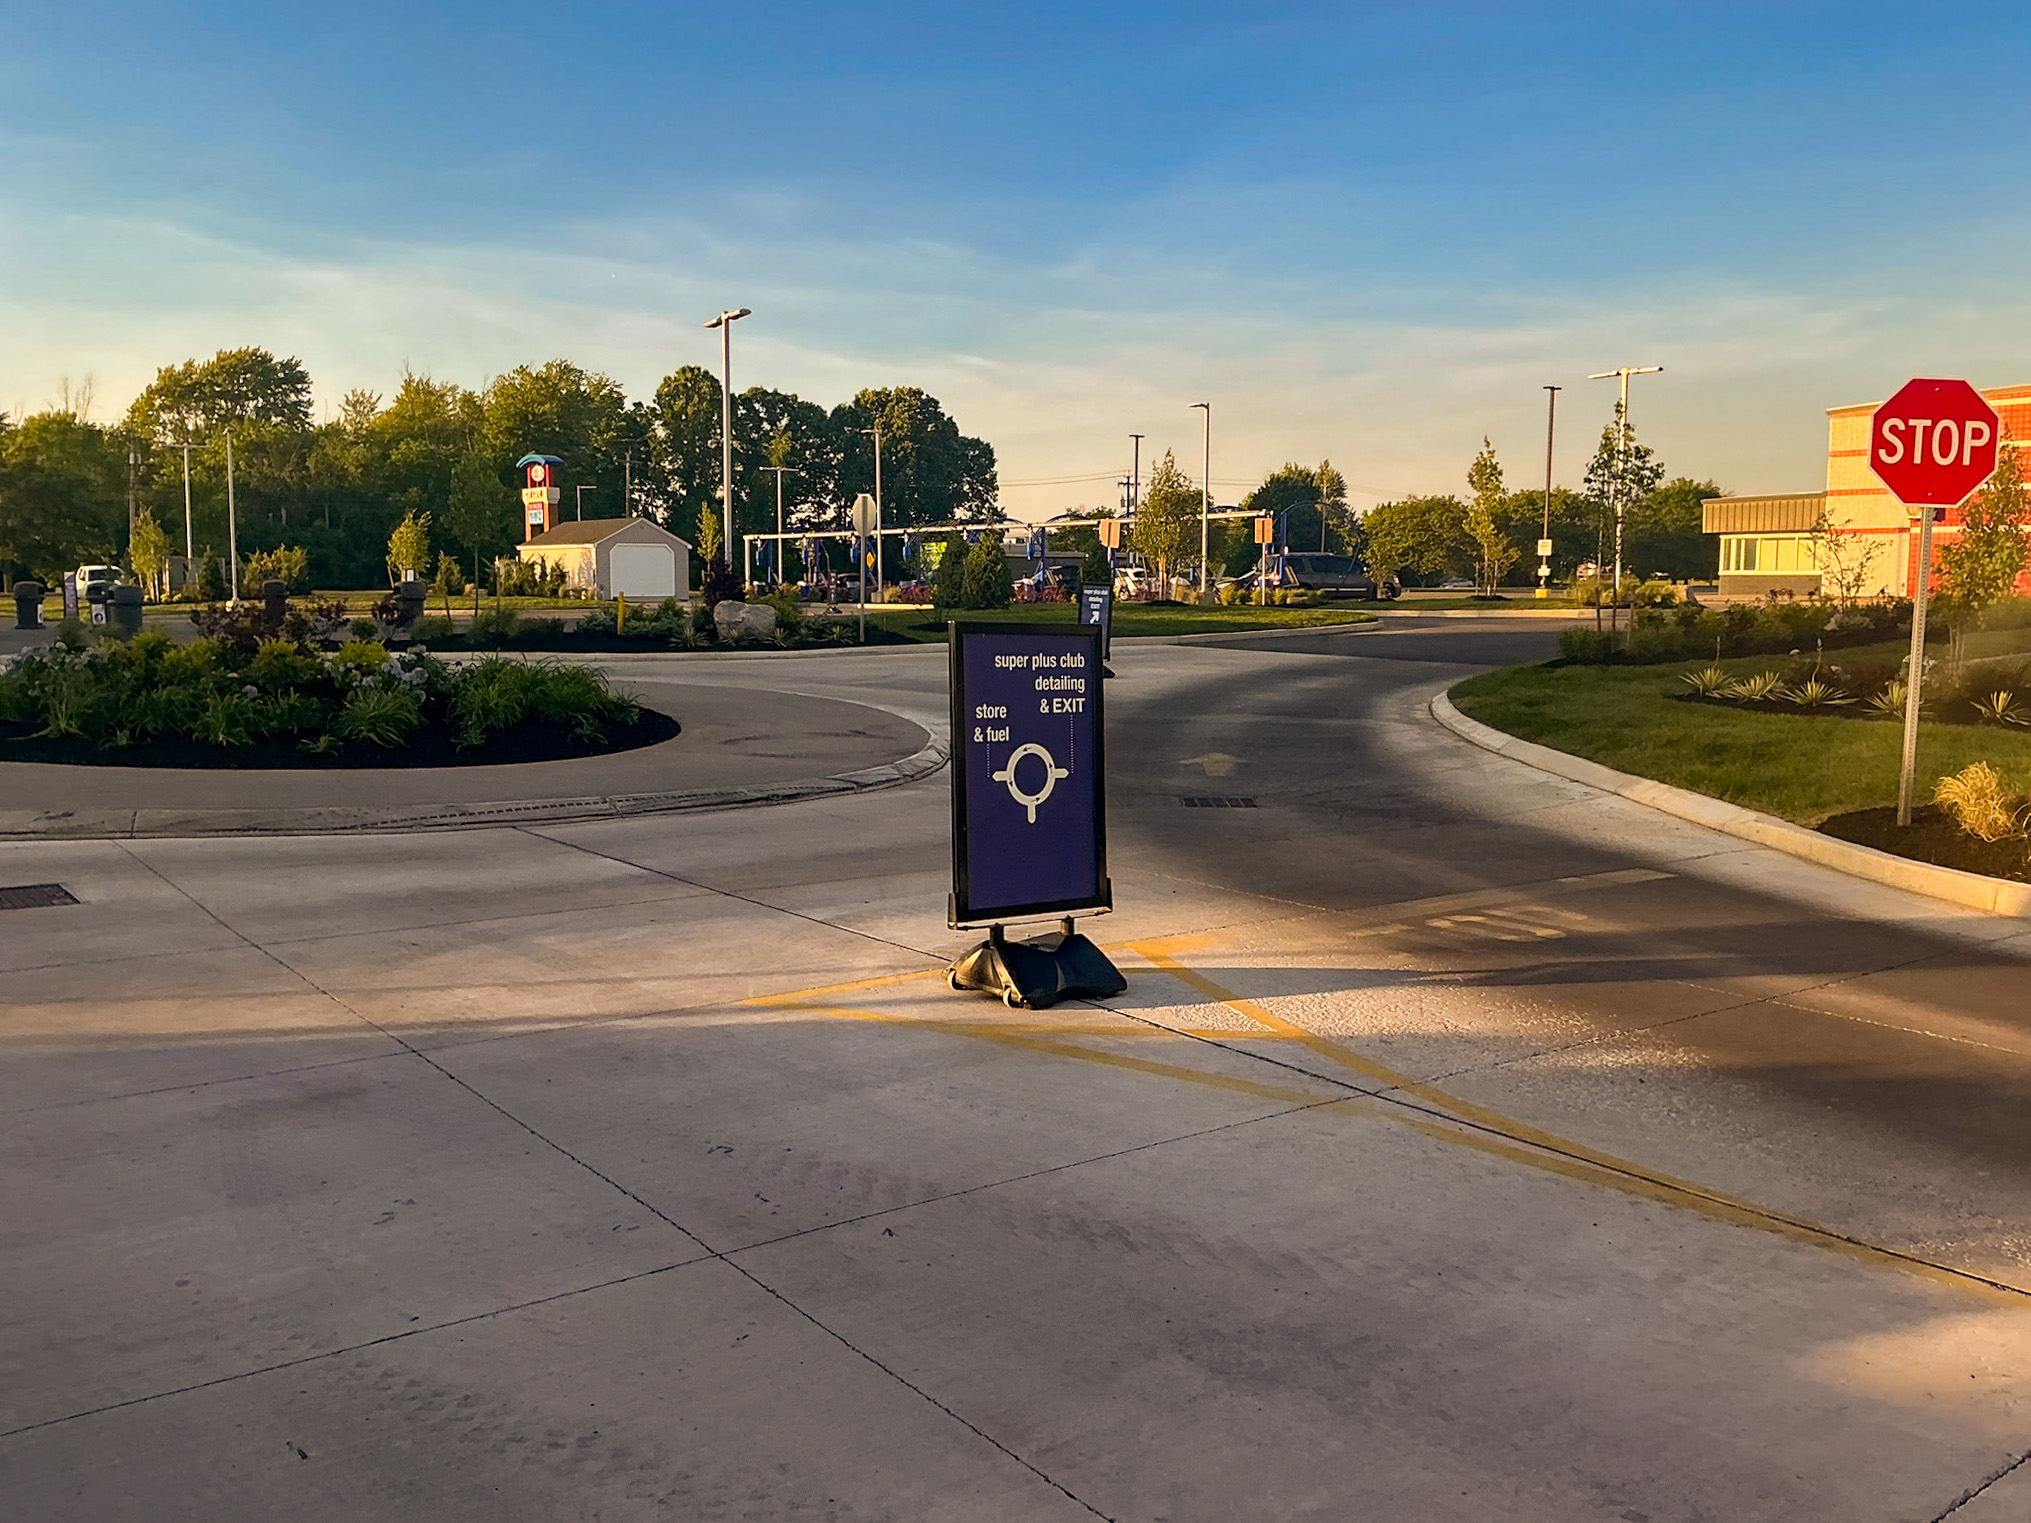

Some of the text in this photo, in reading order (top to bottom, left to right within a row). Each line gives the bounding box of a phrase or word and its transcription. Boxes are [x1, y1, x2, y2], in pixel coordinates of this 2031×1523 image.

[1878, 417, 1991, 466] STOP
[994, 652, 1085, 671] super plus club
[1035, 675, 1085, 693] detailing
[975, 703, 1008, 719] store
[1040, 698, 1086, 713] & EXIT
[973, 726, 1009, 742] & fuel
